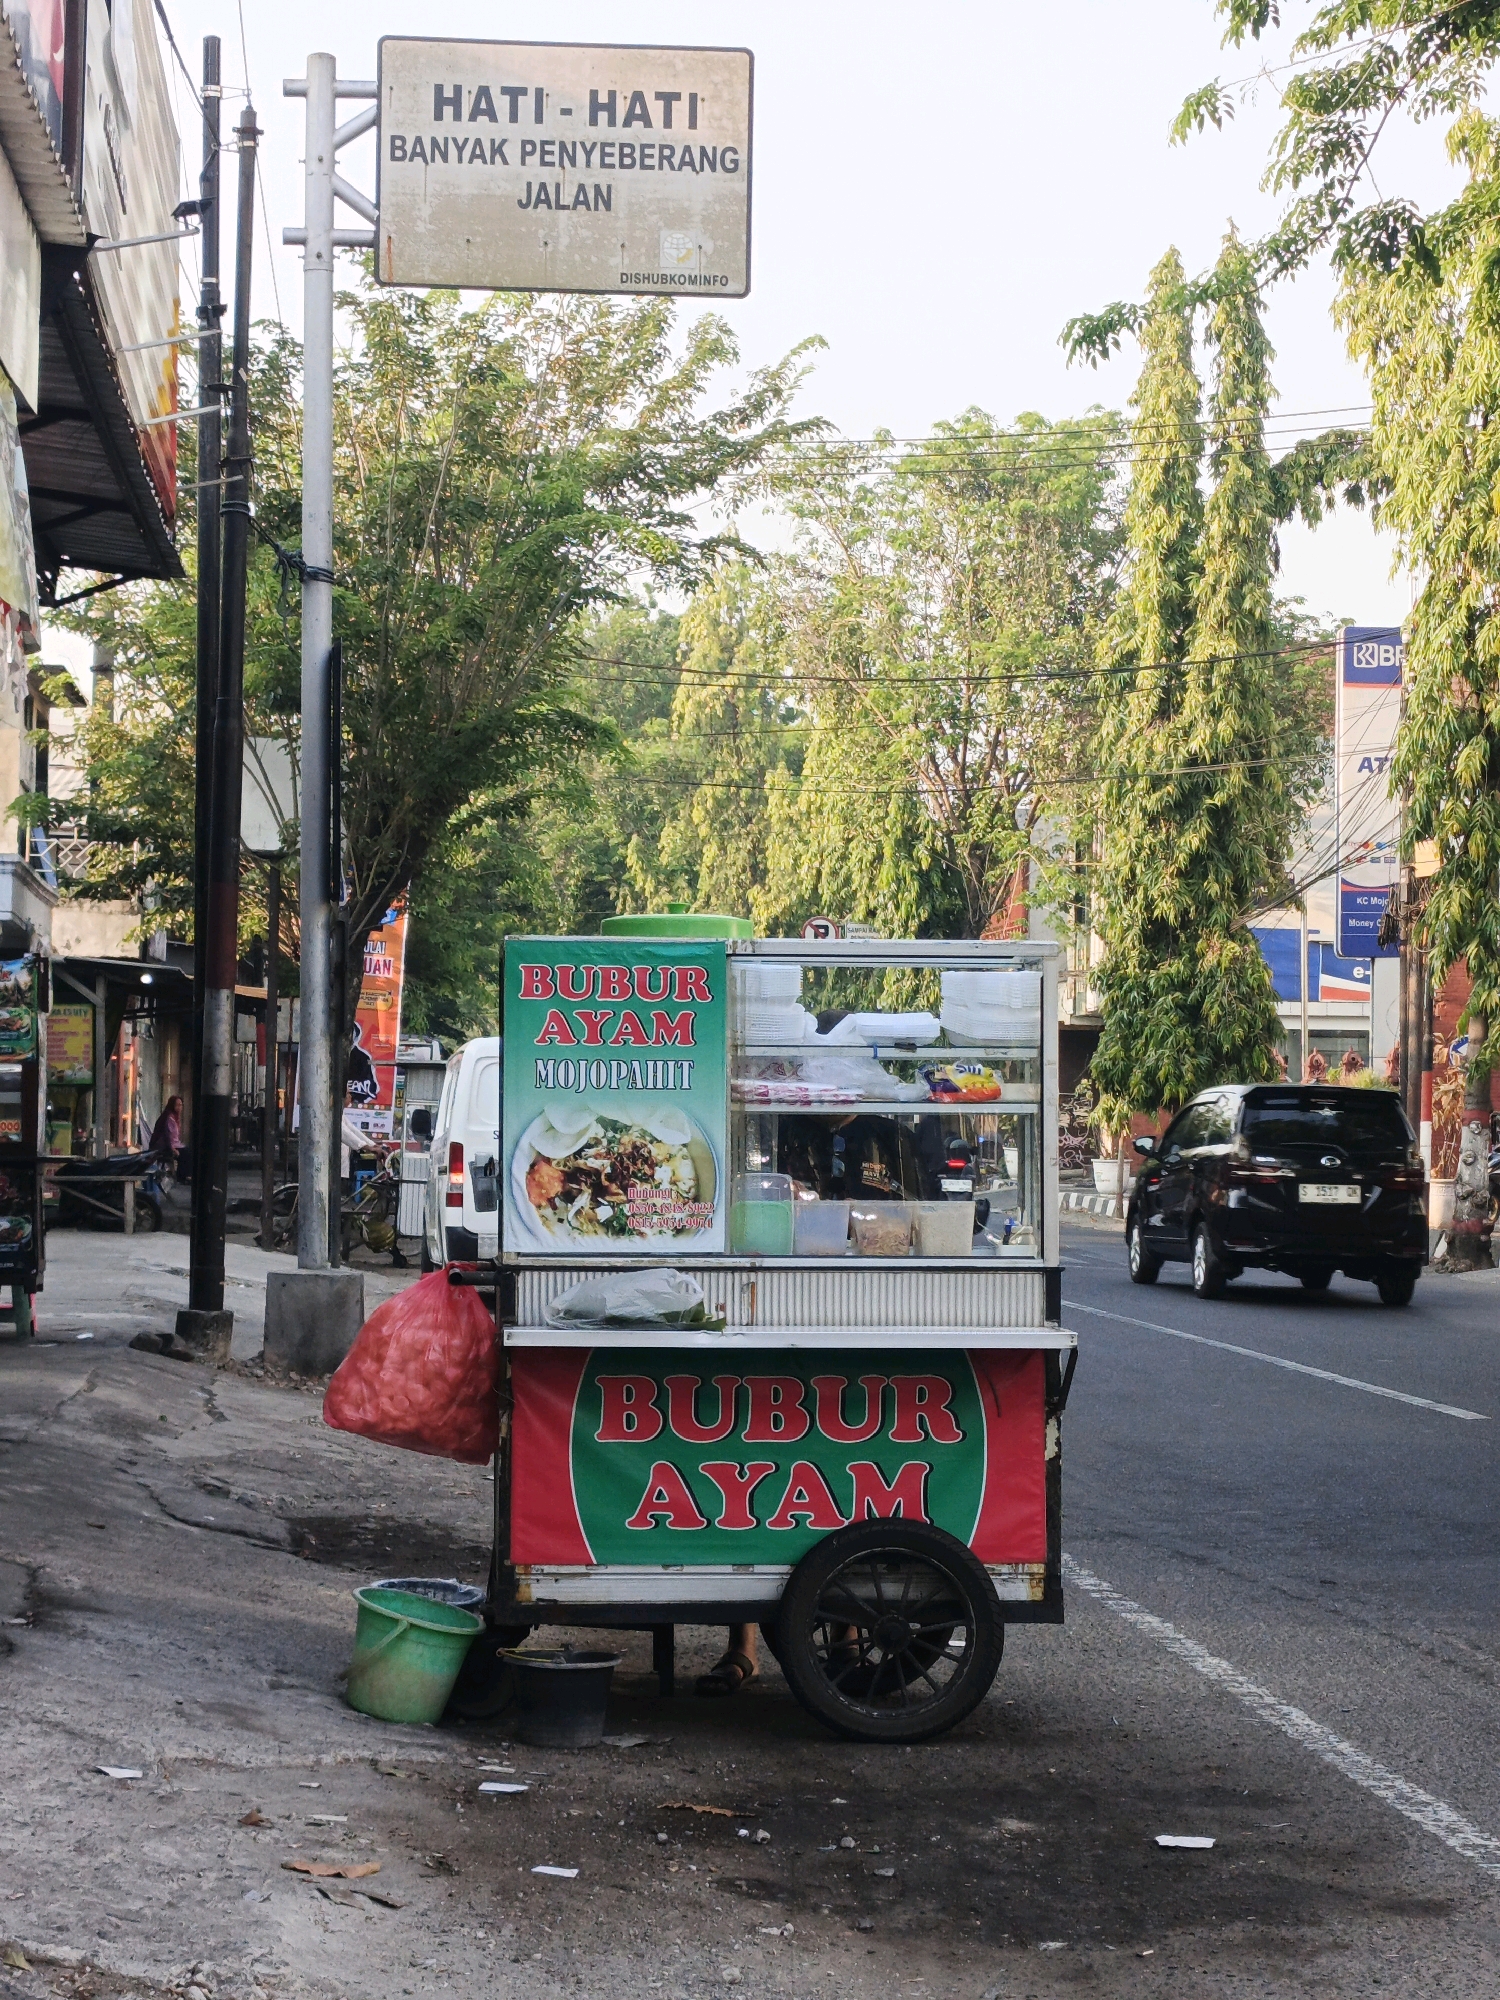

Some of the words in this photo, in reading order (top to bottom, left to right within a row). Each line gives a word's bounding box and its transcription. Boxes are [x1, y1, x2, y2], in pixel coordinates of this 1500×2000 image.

[433, 84, 545, 125] HATI
[588, 89, 699, 130] HATI
[389, 134, 510, 167] BANYAK
[520, 139, 740, 174] PENYEBERANG
[517, 181, 612, 212] JALAN
[620, 272, 729, 287] DISHUBKOMINFO
[1356, 896, 1369, 905] KC
[1348, 918, 1374, 929] Money
[518, 964, 714, 1002] BUBUR
[534, 1008, 698, 1047] AYAM
[535, 1058, 695, 1094] MOJOPAHIT
[594, 1374, 967, 1444] BUBUR
[625, 1460, 934, 1530] AYAM
